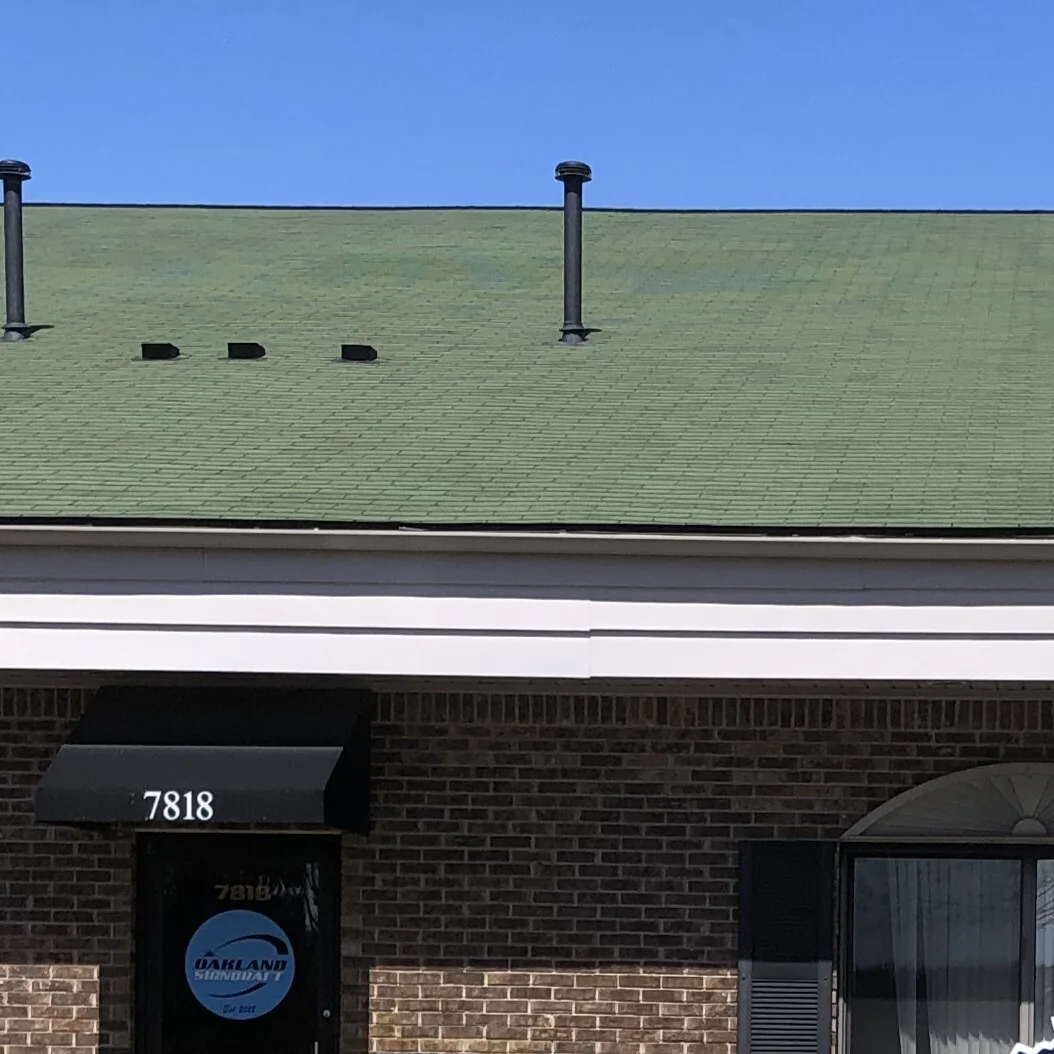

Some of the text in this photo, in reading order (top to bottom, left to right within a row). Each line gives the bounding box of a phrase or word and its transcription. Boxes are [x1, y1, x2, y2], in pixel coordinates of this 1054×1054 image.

[143, 790, 213, 821] 7818
[214, 884, 272, 901] 7818
[194, 958, 288, 972] OAKLAND
